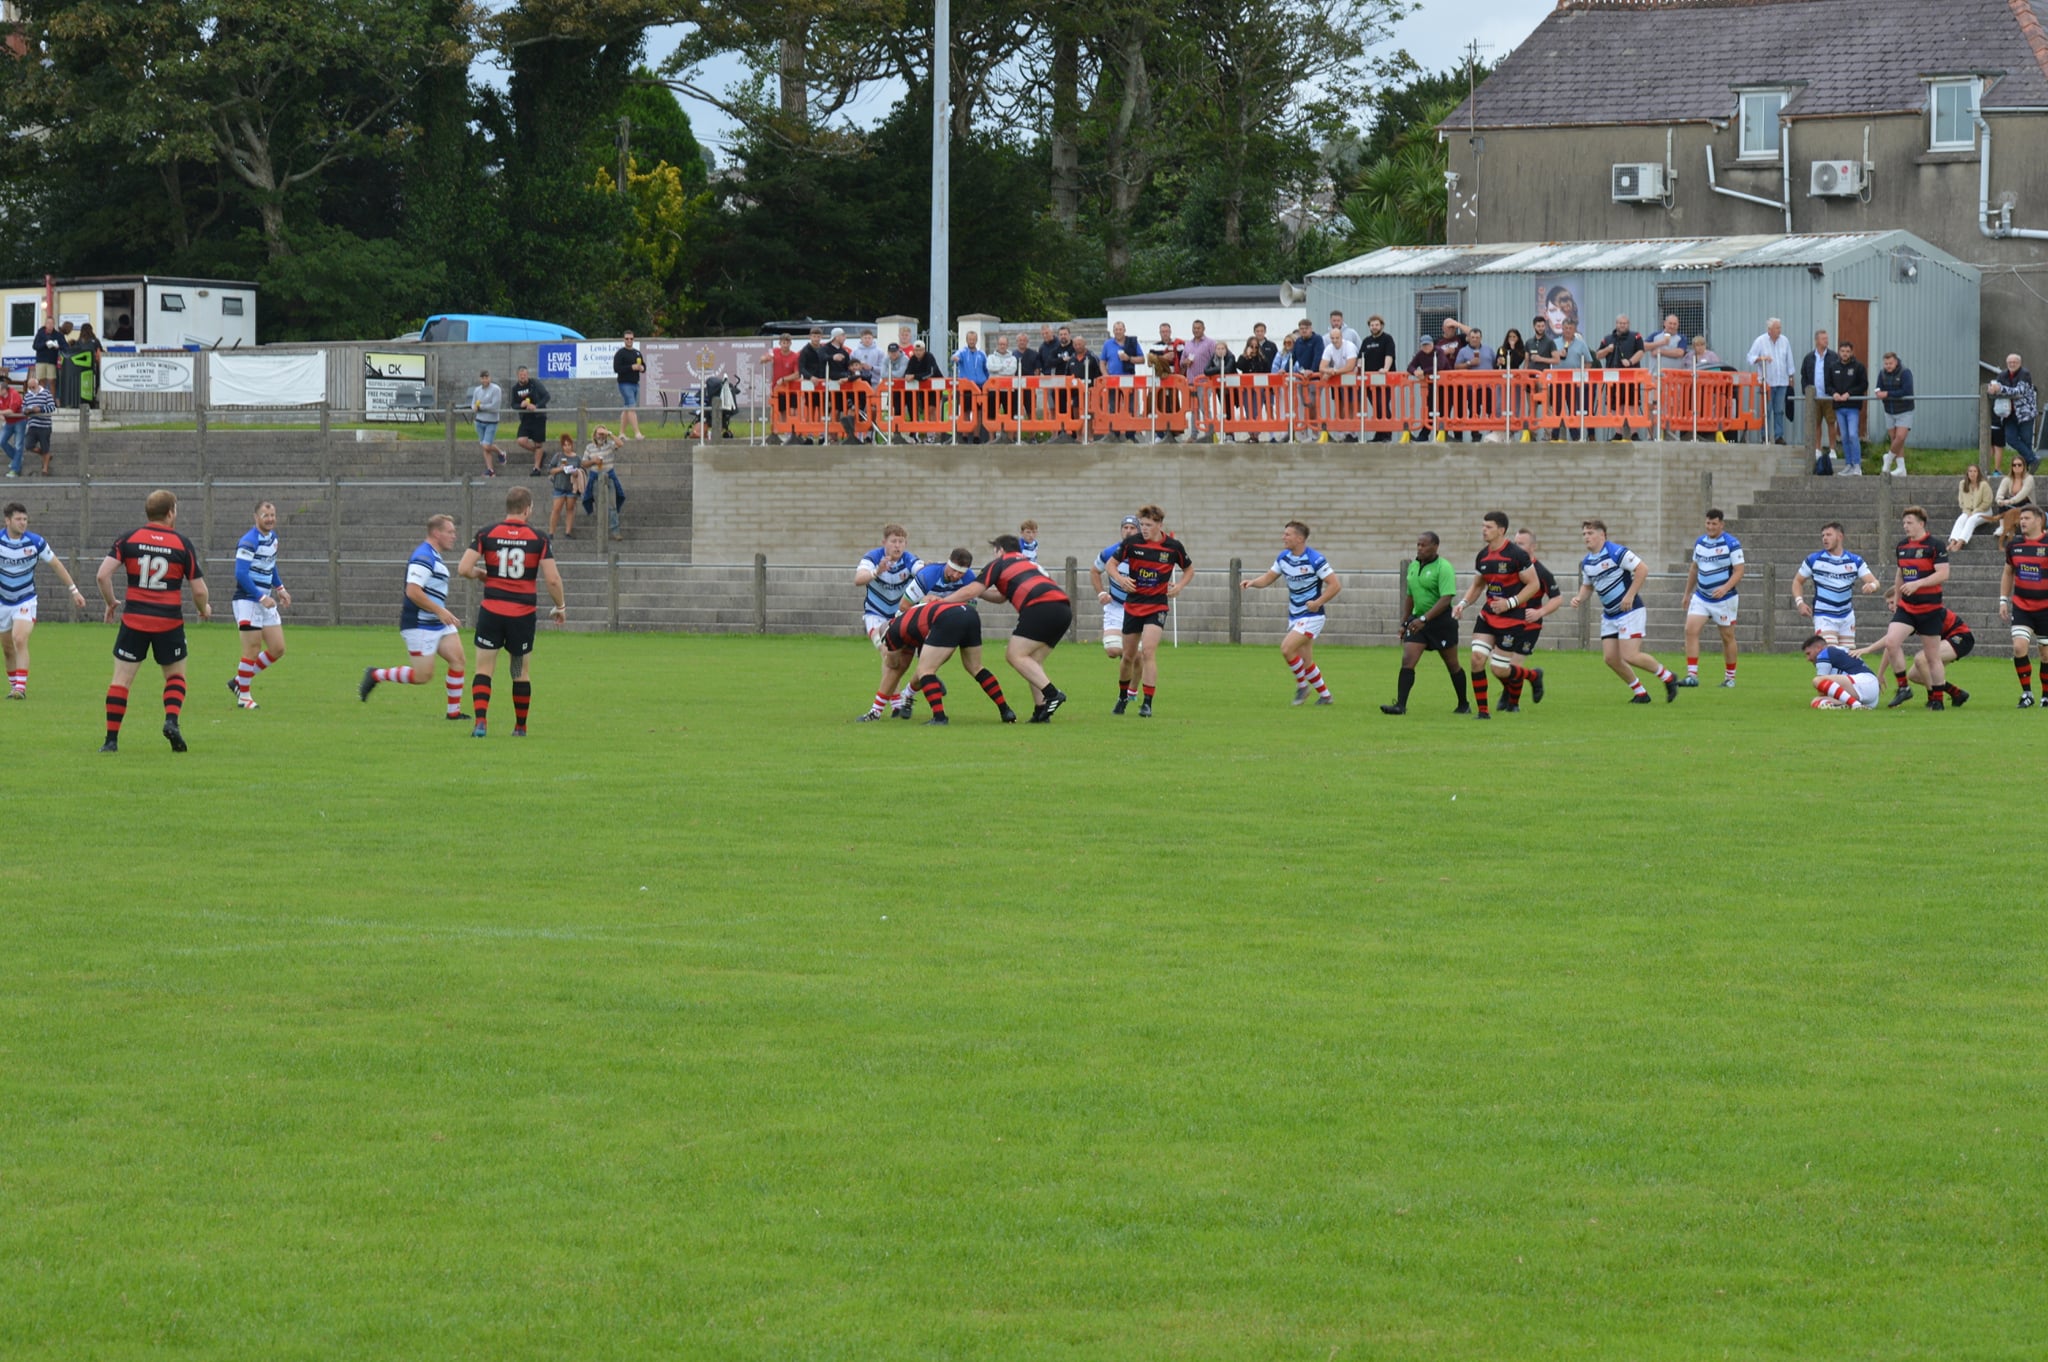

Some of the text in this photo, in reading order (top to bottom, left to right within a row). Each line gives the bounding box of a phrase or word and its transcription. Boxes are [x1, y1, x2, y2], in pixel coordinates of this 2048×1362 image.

[548, 352, 572, 362] LEWIS
[388, 363, 402, 375] CK
[548, 361, 572, 372] LEWIS
[496, 538, 527, 546] SEASIDERS
[138, 543, 172, 555] SEASIDERS
[496, 547, 525, 579] 13
[138, 554, 169, 590] 12
